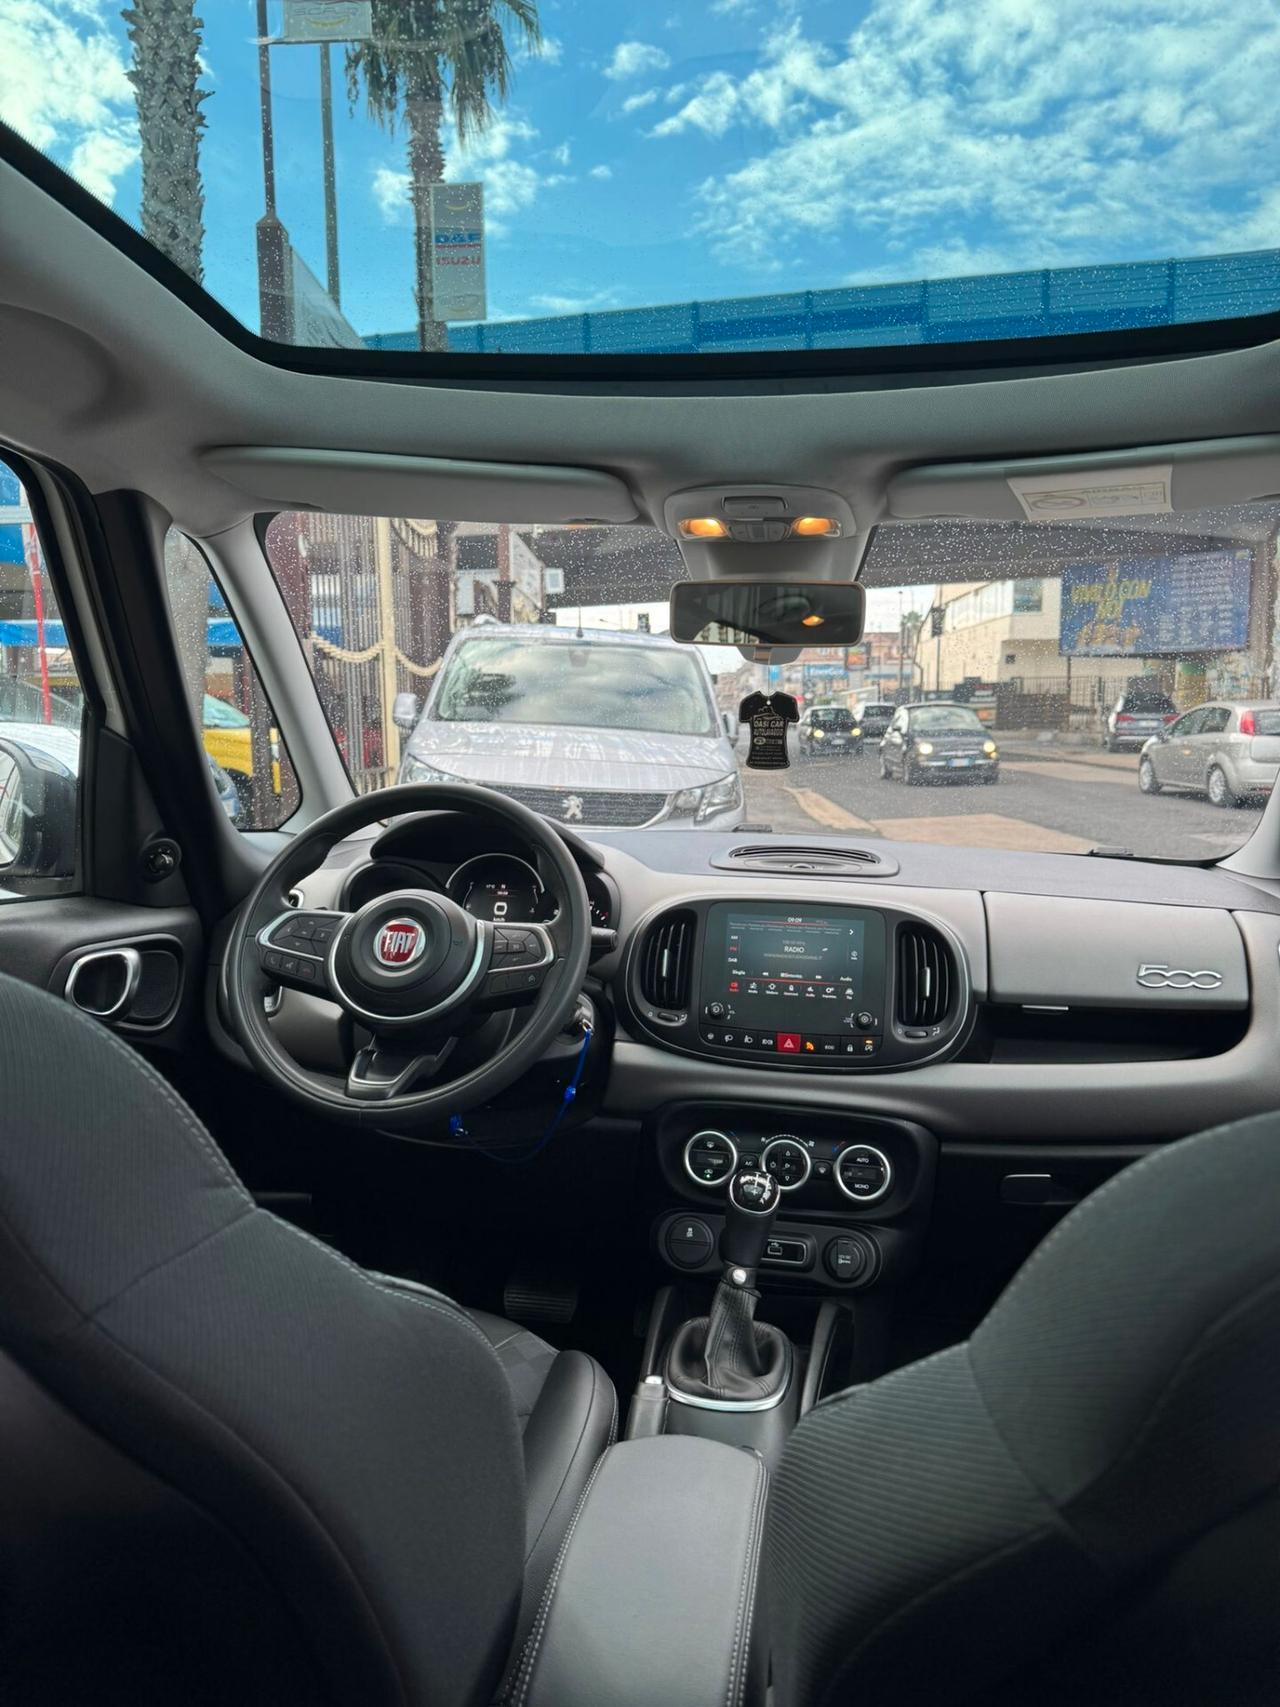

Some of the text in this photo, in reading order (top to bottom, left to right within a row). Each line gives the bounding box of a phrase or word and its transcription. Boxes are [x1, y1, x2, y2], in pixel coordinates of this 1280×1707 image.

[494, 902, 508, 916] 0
[383, 930, 416, 954] FIAT
[784, 945, 805, 953] RADIO
[1137, 964, 1222, 988] 500
